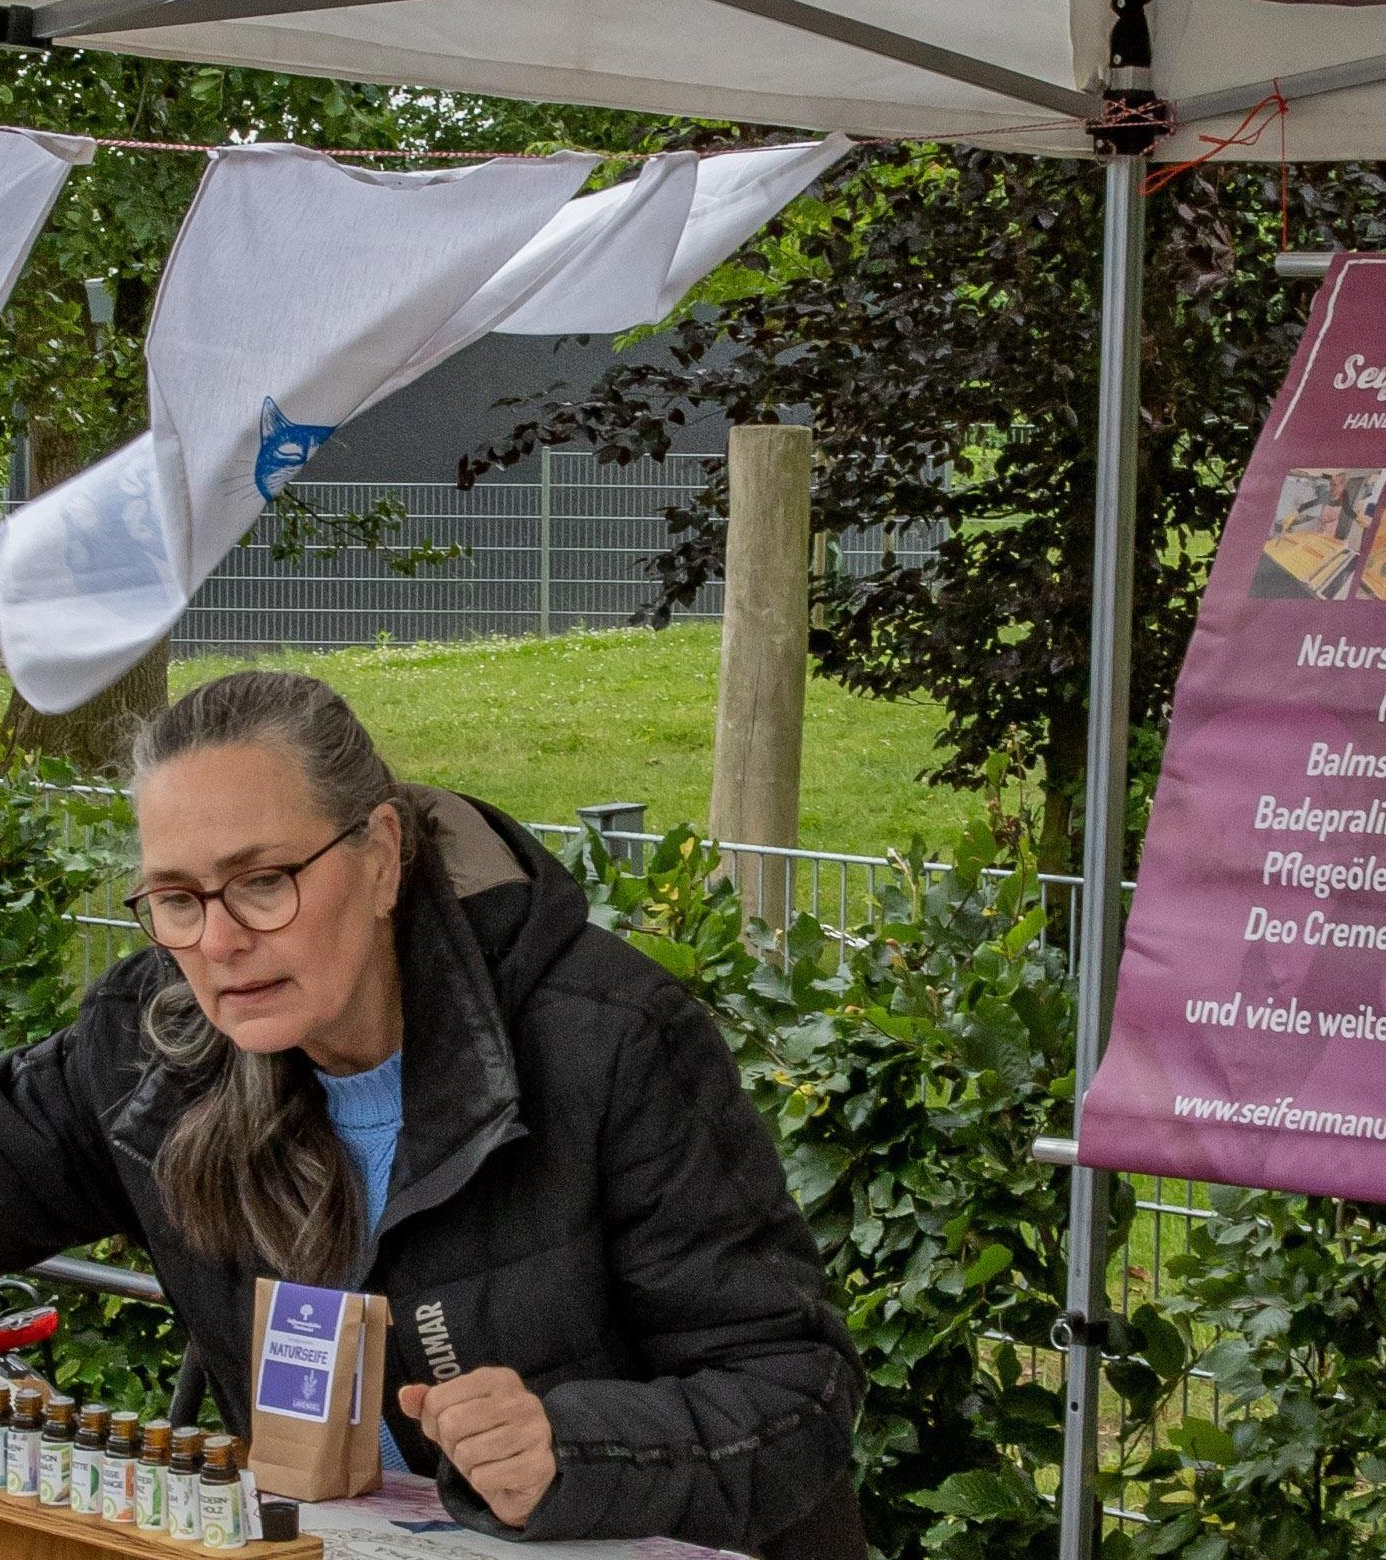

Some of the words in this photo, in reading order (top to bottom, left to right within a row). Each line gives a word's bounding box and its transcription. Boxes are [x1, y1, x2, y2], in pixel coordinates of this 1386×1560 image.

[1243, 907, 1297, 944] Deo
[1184, 992, 1242, 1028] und
[1244, 996, 1311, 1036] viele
[269, 1341, 329, 1366] NATURSEIFE
[415, 1300, 462, 1382] OLMAR
